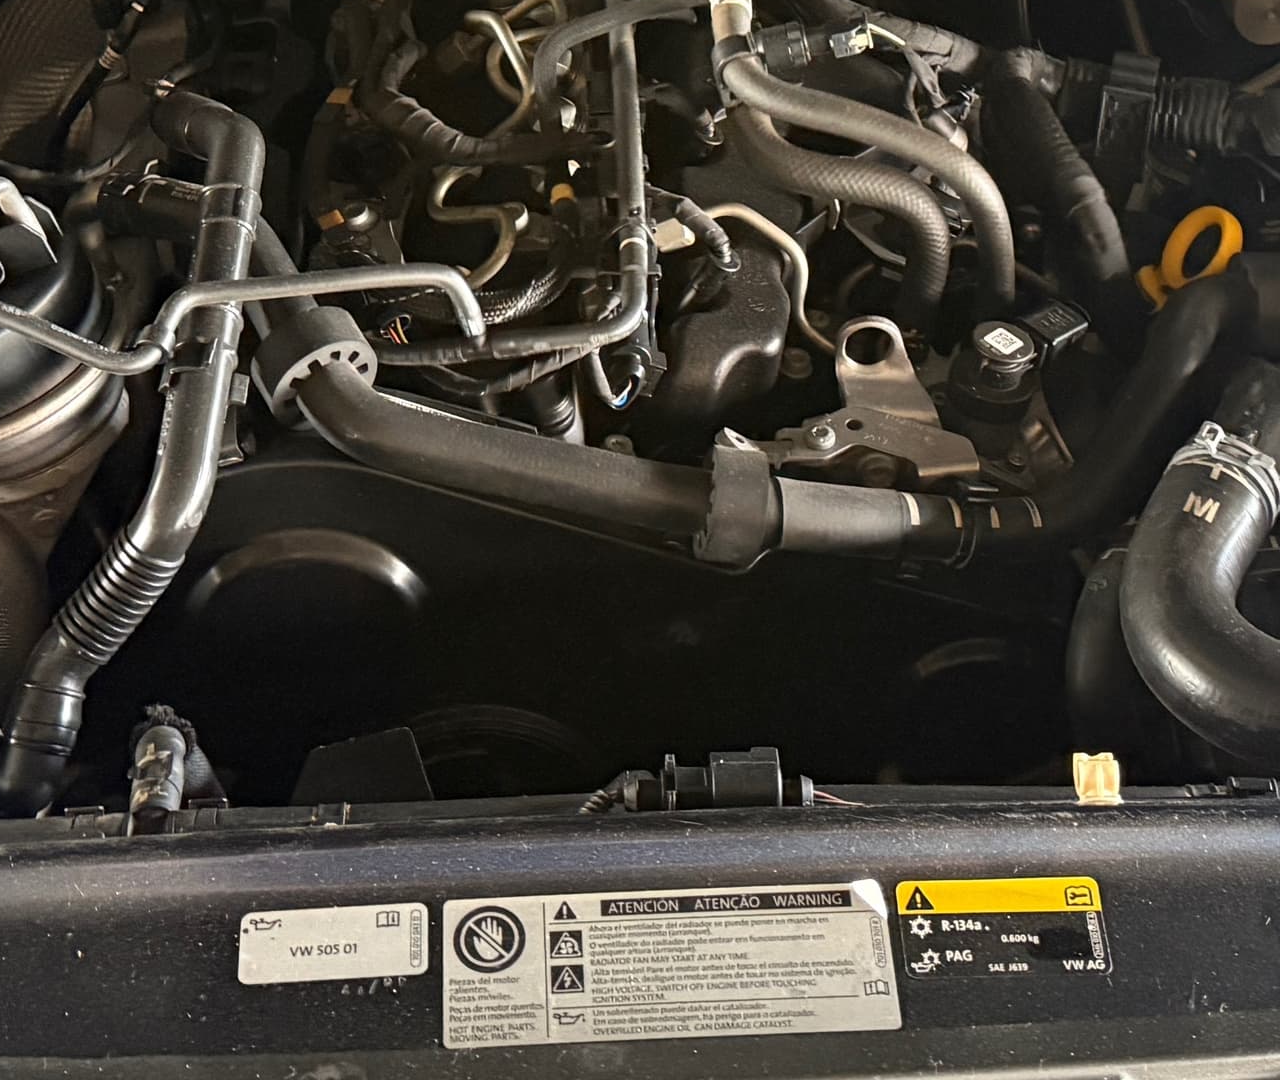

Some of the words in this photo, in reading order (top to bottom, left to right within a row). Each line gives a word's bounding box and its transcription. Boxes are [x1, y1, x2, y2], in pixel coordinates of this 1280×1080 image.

[1182, 490, 1221, 524] M
[694, 893, 761, 912] ATENÇÃO
[772, 892, 843, 908] WARNING
[289, 945, 312, 958] VW
[317, 943, 340, 956] 505
[343, 943, 358, 954] 01
[945, 949, 974, 962] PAG
[590, 957, 631, 966] RADIATOR
[632, 956, 650, 965] FAN
[653, 955, 670, 964] MAY
[671, 954, 695, 963] START
[696, 953, 708, 962] AT
[709, 952, 727, 961] ANY
[1062, 959, 1085, 971] VW
[1086, 958, 1106, 970] AG
[988, 963, 1006, 972] SAE
[591, 986, 614, 995] HIGH
[655, 984, 688, 992] SWITCH
[689, 983, 705, 992] OFF
[706, 982, 738, 991] ENGINE
[739, 980, 770, 989] BEFORE
[592, 995, 630, 1003] IGNITION
[448, 1025, 469, 1035] HOT
[471, 1024, 506, 1033] ENGINE
[593, 1027, 643, 1036] OVERFILLED
[644, 1025, 675, 1033] ENGINE
[693, 1023, 713, 1032] CAN
[714, 1021, 752, 1030] DAMAGE
[449, 1033, 488, 1043] MOVING
